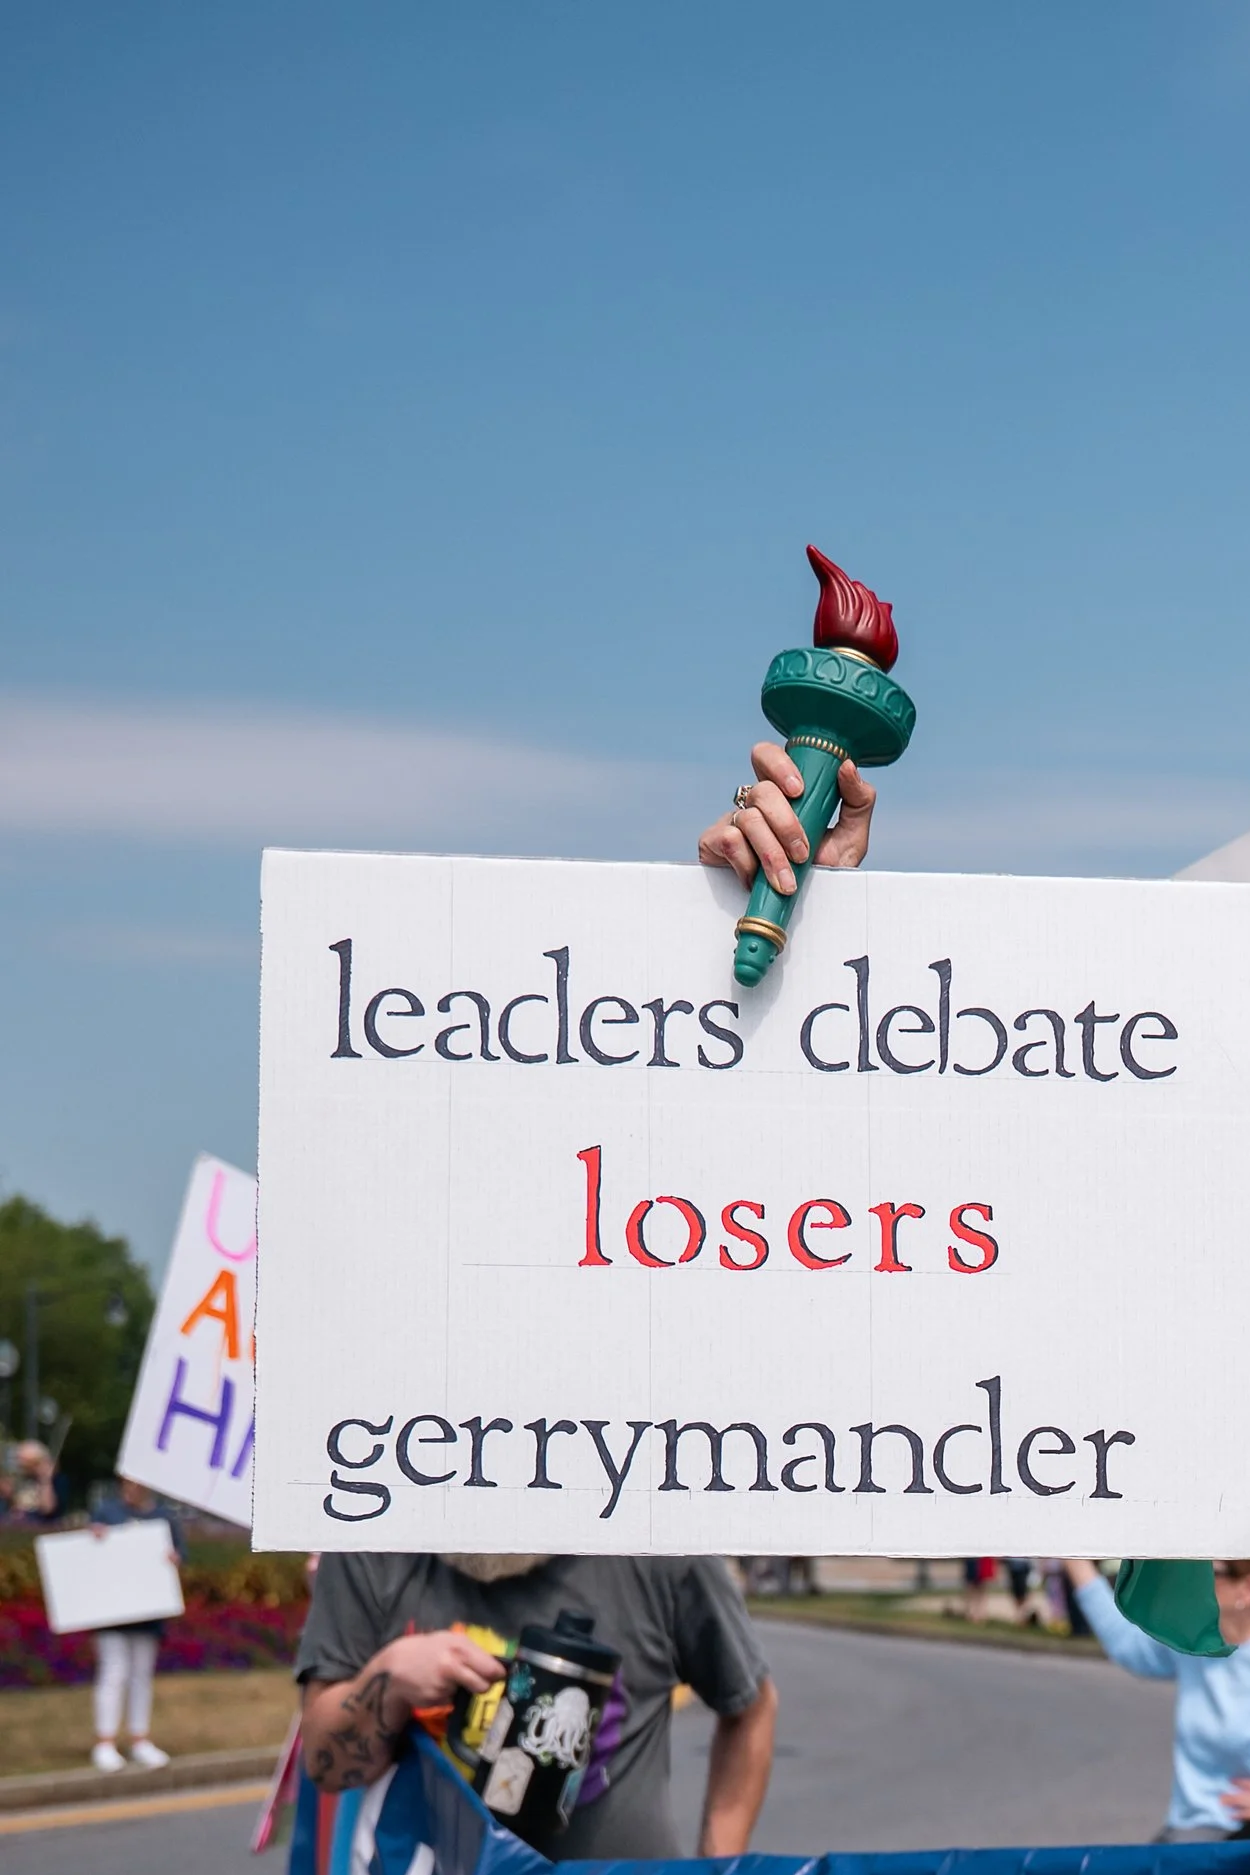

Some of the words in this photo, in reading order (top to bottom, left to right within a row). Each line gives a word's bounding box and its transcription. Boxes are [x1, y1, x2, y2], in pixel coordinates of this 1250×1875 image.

[329, 938, 743, 1070] leaders
[800, 954, 1178, 1082] debate
[577, 1145, 998, 1275] losers
[323, 1376, 1135, 1522] gerrymander
